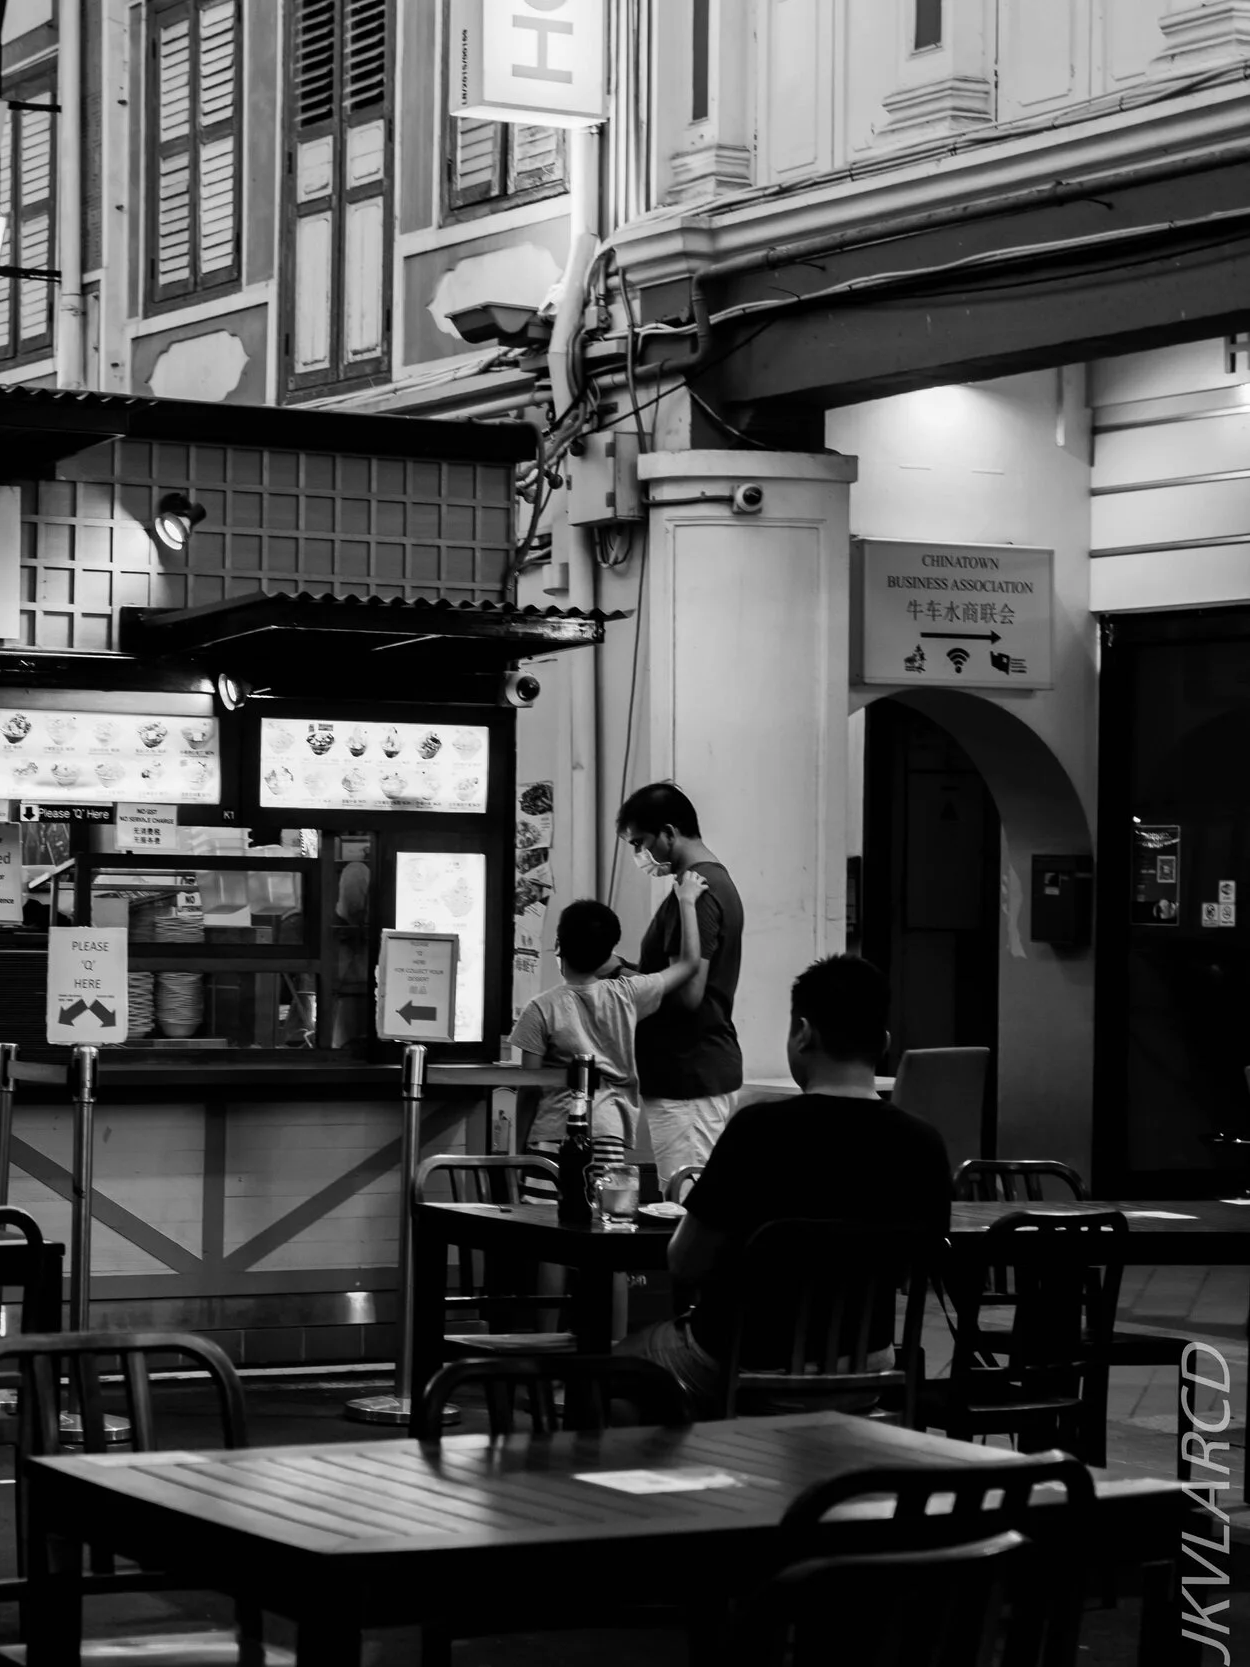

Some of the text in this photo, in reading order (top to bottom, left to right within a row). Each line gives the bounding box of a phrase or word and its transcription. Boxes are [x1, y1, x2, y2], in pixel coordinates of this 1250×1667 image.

[921, 554, 999, 570] CHINATOWN
[887, 575, 1034, 594] BUSINESS ASSOCIATION
[906, 599, 1015, 624] 牛车水商联会
[39, 807, 70, 819] Please
[86, 808, 110, 819] Here
[72, 941, 109, 952] PLEASE
[74, 979, 101, 989] HERE
